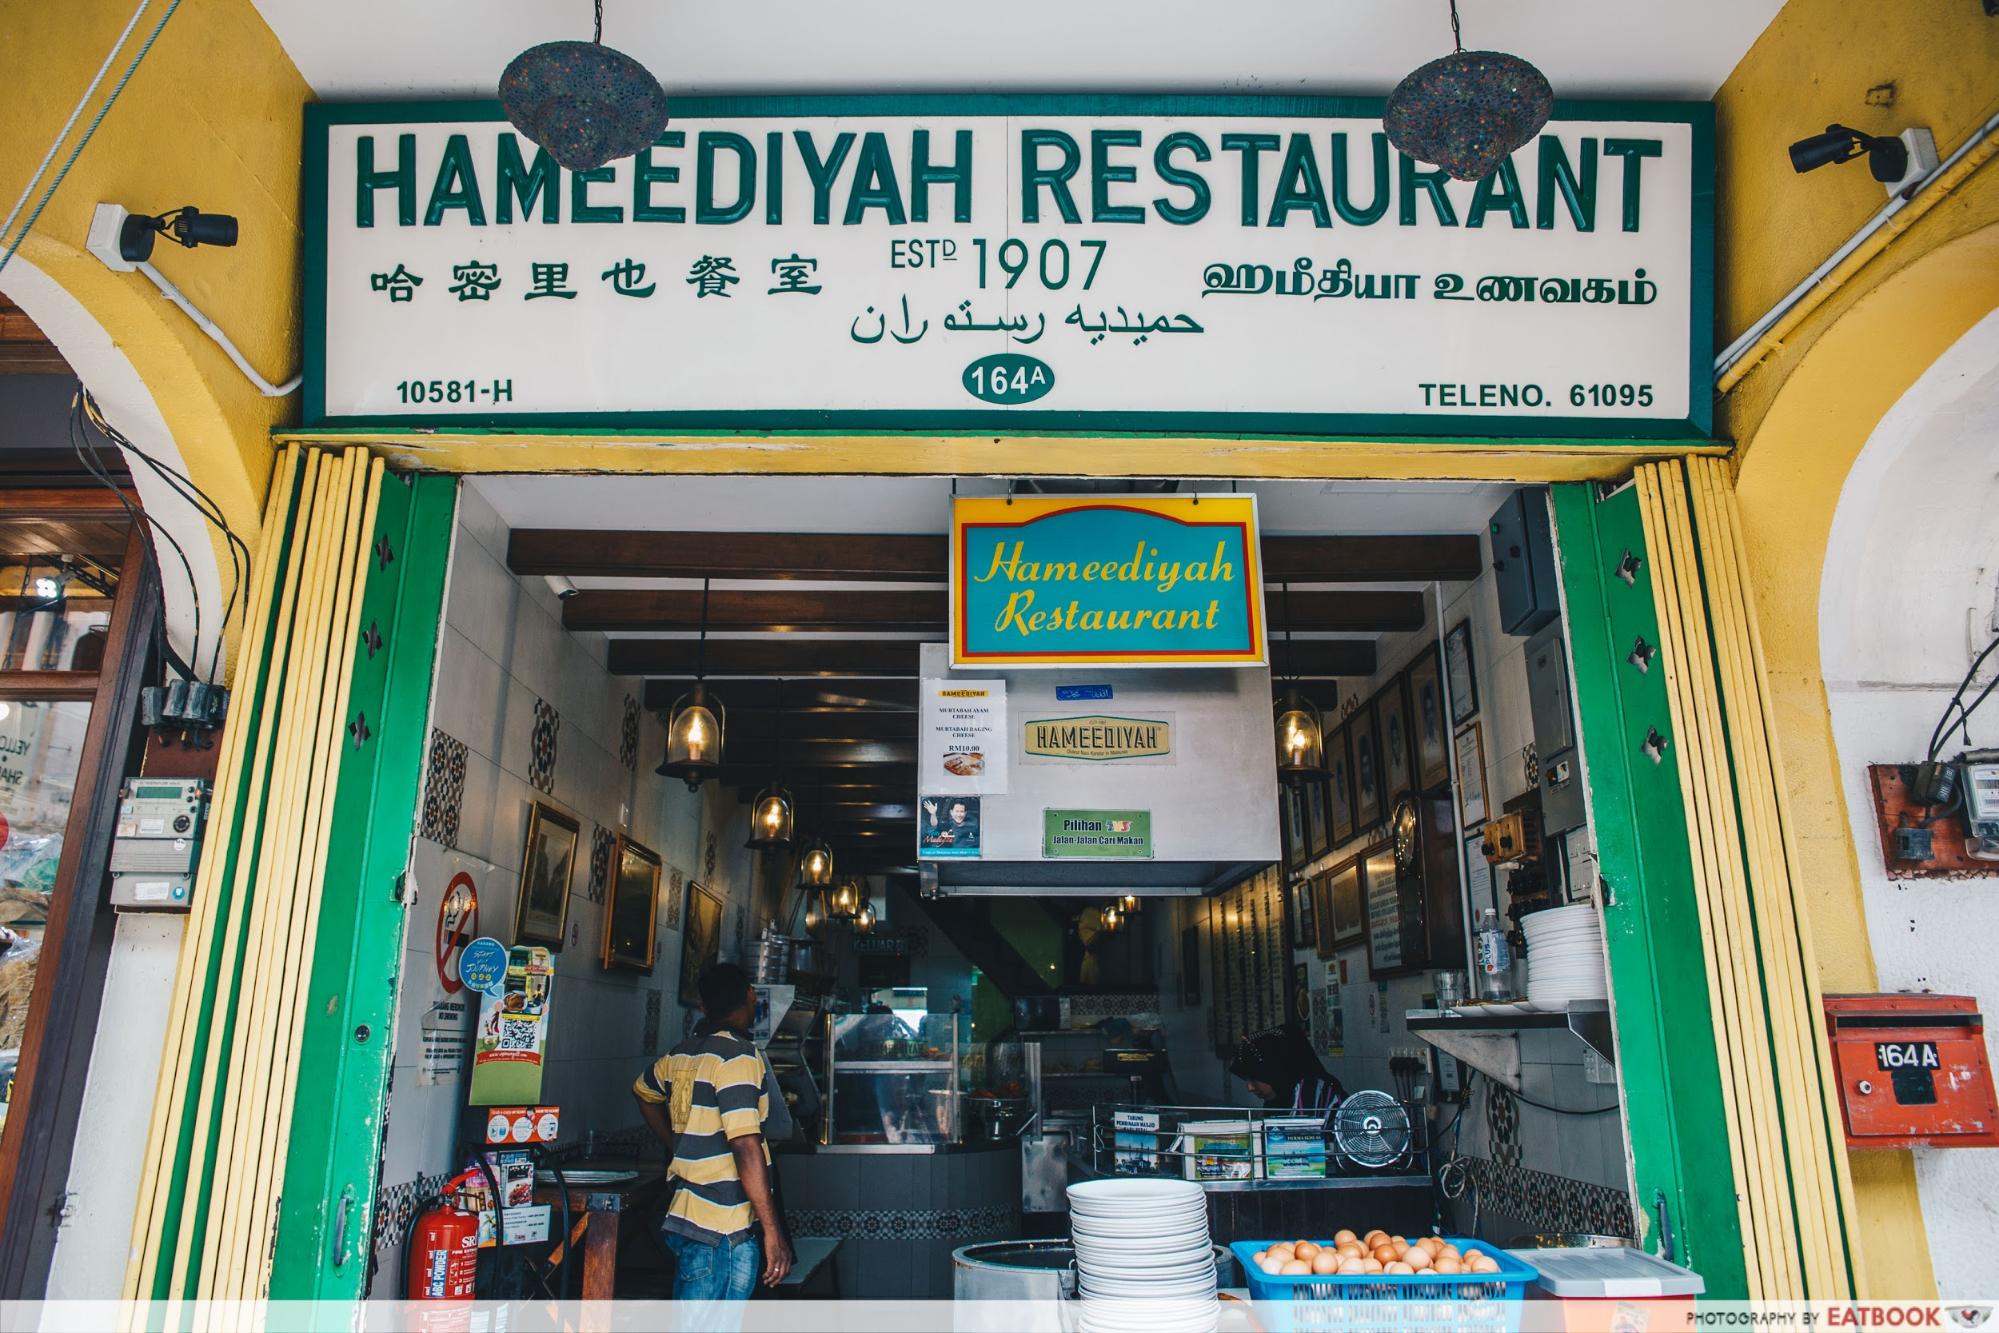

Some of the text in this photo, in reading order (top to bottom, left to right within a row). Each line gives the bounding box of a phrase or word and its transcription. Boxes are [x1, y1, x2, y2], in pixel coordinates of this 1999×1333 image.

[357, 129, 1662, 232] HAMEEDIYAH RESTAURANT
[370, 253, 823, 303] 哈密里也餐室
[973, 238, 1107, 290] 1907
[1433, 267, 1658, 305] உணவகம்
[396, 379, 513, 405] 10581-H
[971, 365, 1046, 395] 164A
[1419, 383, 1654, 407] TELENO. 61095
[974, 541, 1235, 593] Hameediyah
[995, 589, 1220, 636] Restaurant
[1037, 725, 1157, 749] HAMEEDIYAH
[1053, 835, 1144, 845] Jalan-Jalan Cari Makan
[1063, 819, 1102, 832] Pilihan
[1878, 1044, 1938, 1067] 164A
[431, 1250, 447, 1296] ABC POWDER
